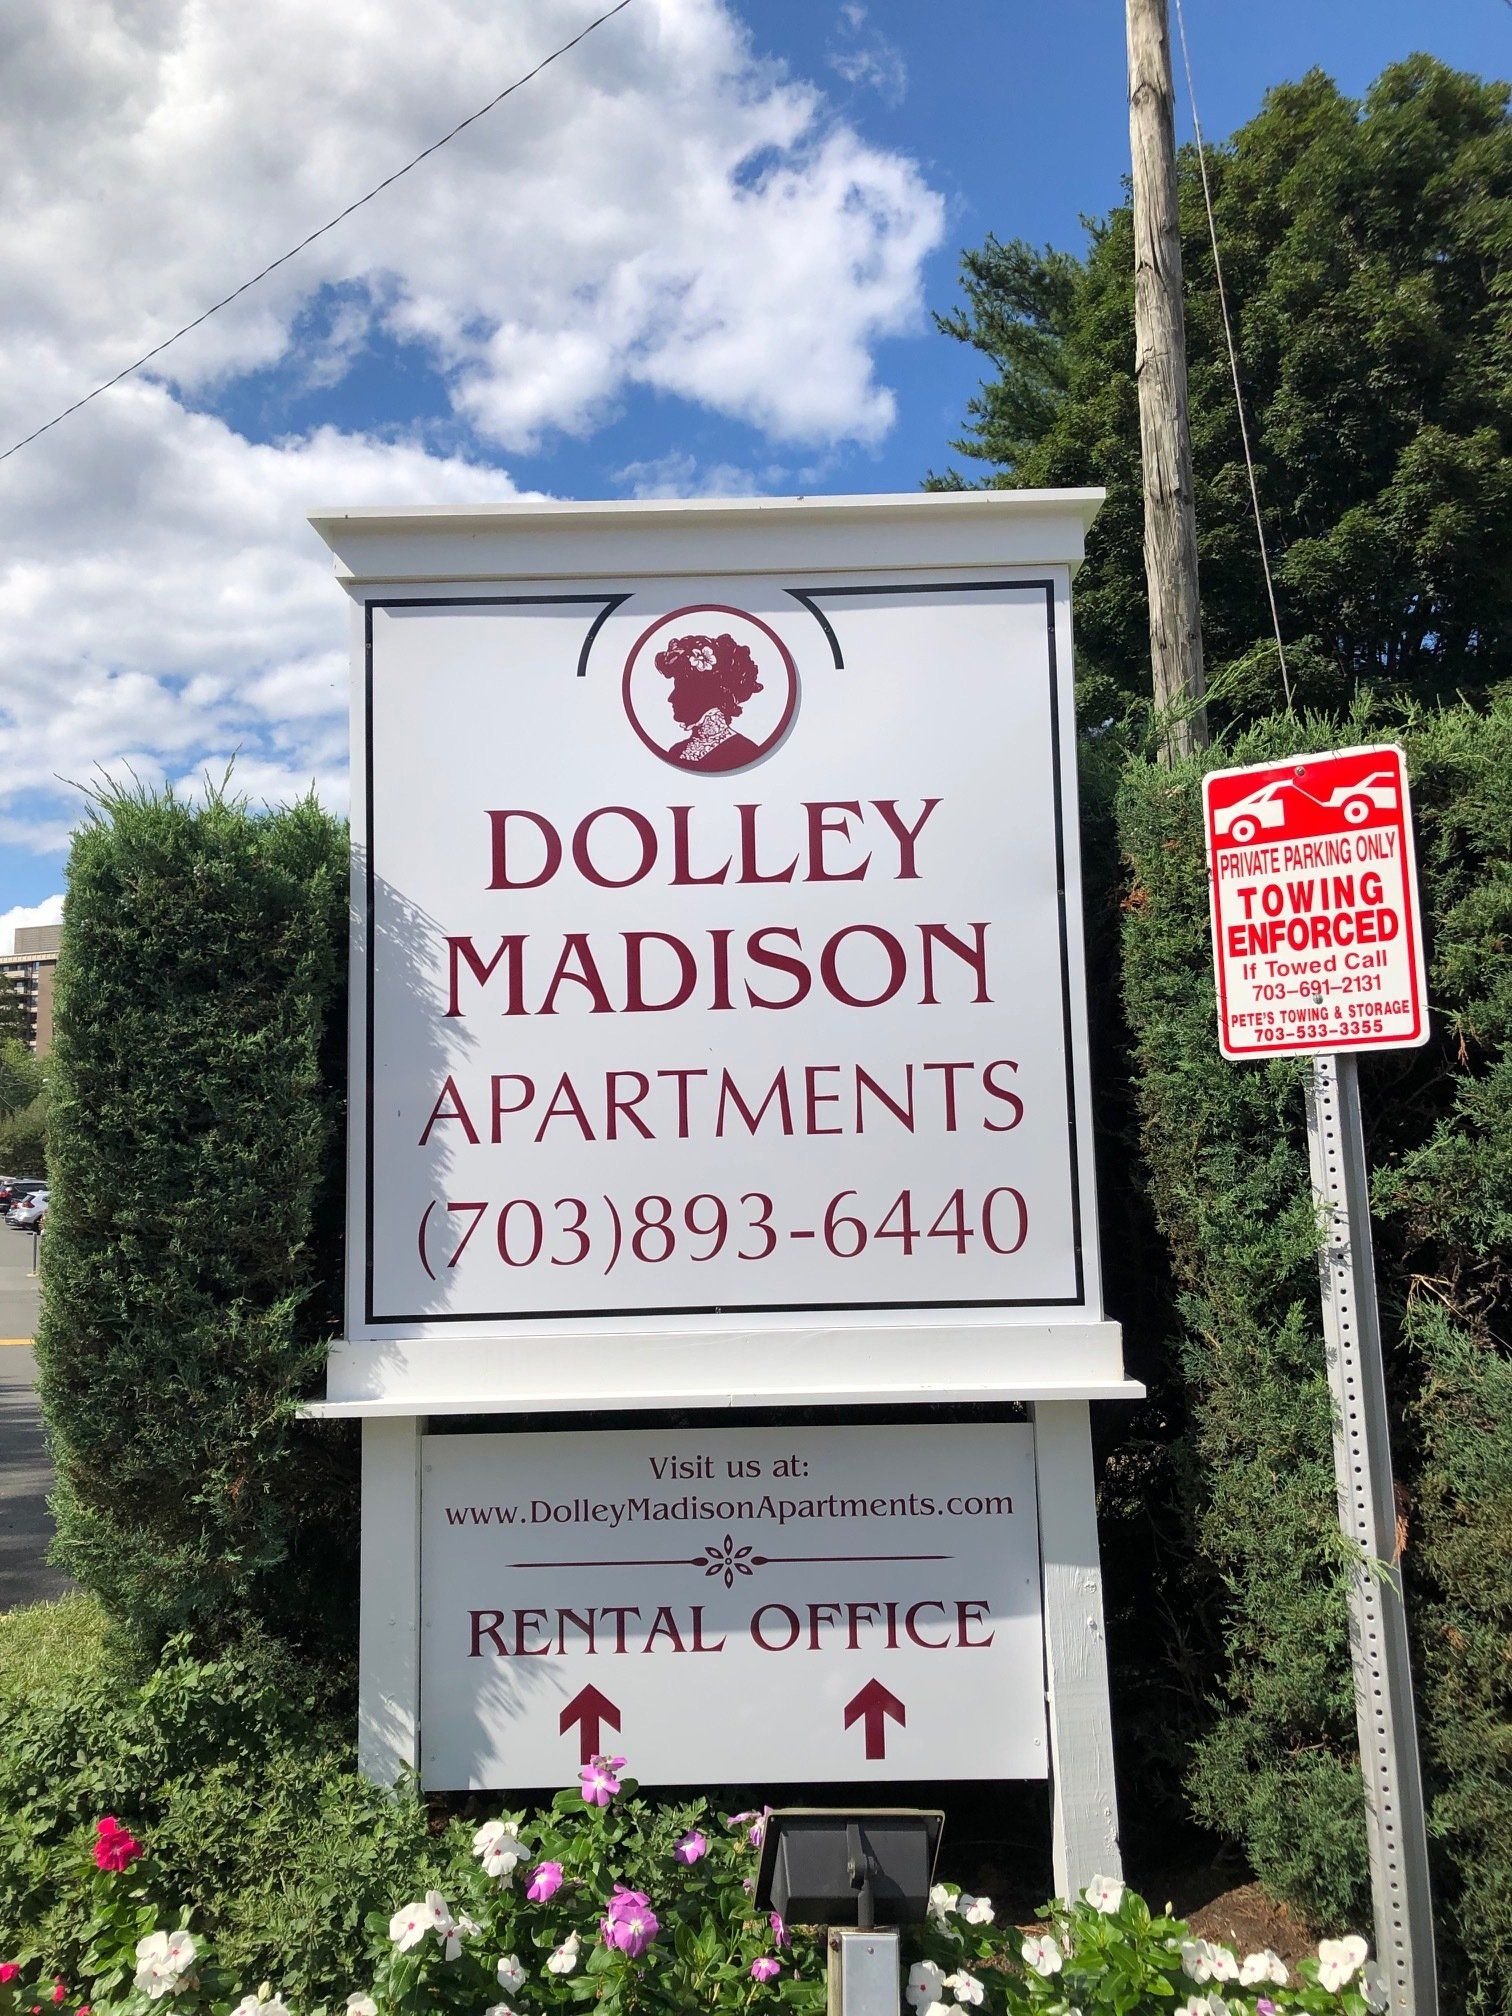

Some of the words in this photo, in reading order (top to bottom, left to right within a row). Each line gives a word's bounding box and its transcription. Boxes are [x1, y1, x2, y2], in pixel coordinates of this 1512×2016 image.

[484, 797, 944, 891] DOLLEY
[1220, 848, 1280, 880] PRIVATE
[1284, 837, 1351, 872] PARKING
[1358, 831, 1396, 862] ONLY
[1237, 871, 1384, 920] TOWING
[1227, 908, 1399, 958] ENFORCED
[442, 922, 995, 1017] MADISON
[1243, 962, 1257, 980] If
[1264, 954, 1337, 977] Towed
[1344, 950, 1388, 970] Call
[1252, 974, 1382, 1001] 703-691-2131
[1231, 1011, 1275, 1028] PETE'S
[1280, 1006, 1329, 1024] TOWING
[1334, 1004, 1343, 1019] &
[1348, 999, 1410, 1018] STORAGE
[1254, 1019, 1383, 1042] 703-533-3355
[418, 1060, 1025, 1146] APARTMENTS
[418, 1187, 1029, 1280] (703)893-6440
[648, 1455, 715, 1480] Visit
[727, 1459, 762, 1479] us
[772, 1455, 810, 1478] at:
[445, 1493, 1014, 1529] www.DolleyMadisonApartments.com
[467, 1605, 727, 1658] RENTAL
[750, 1600, 996, 1651] OFFICE
